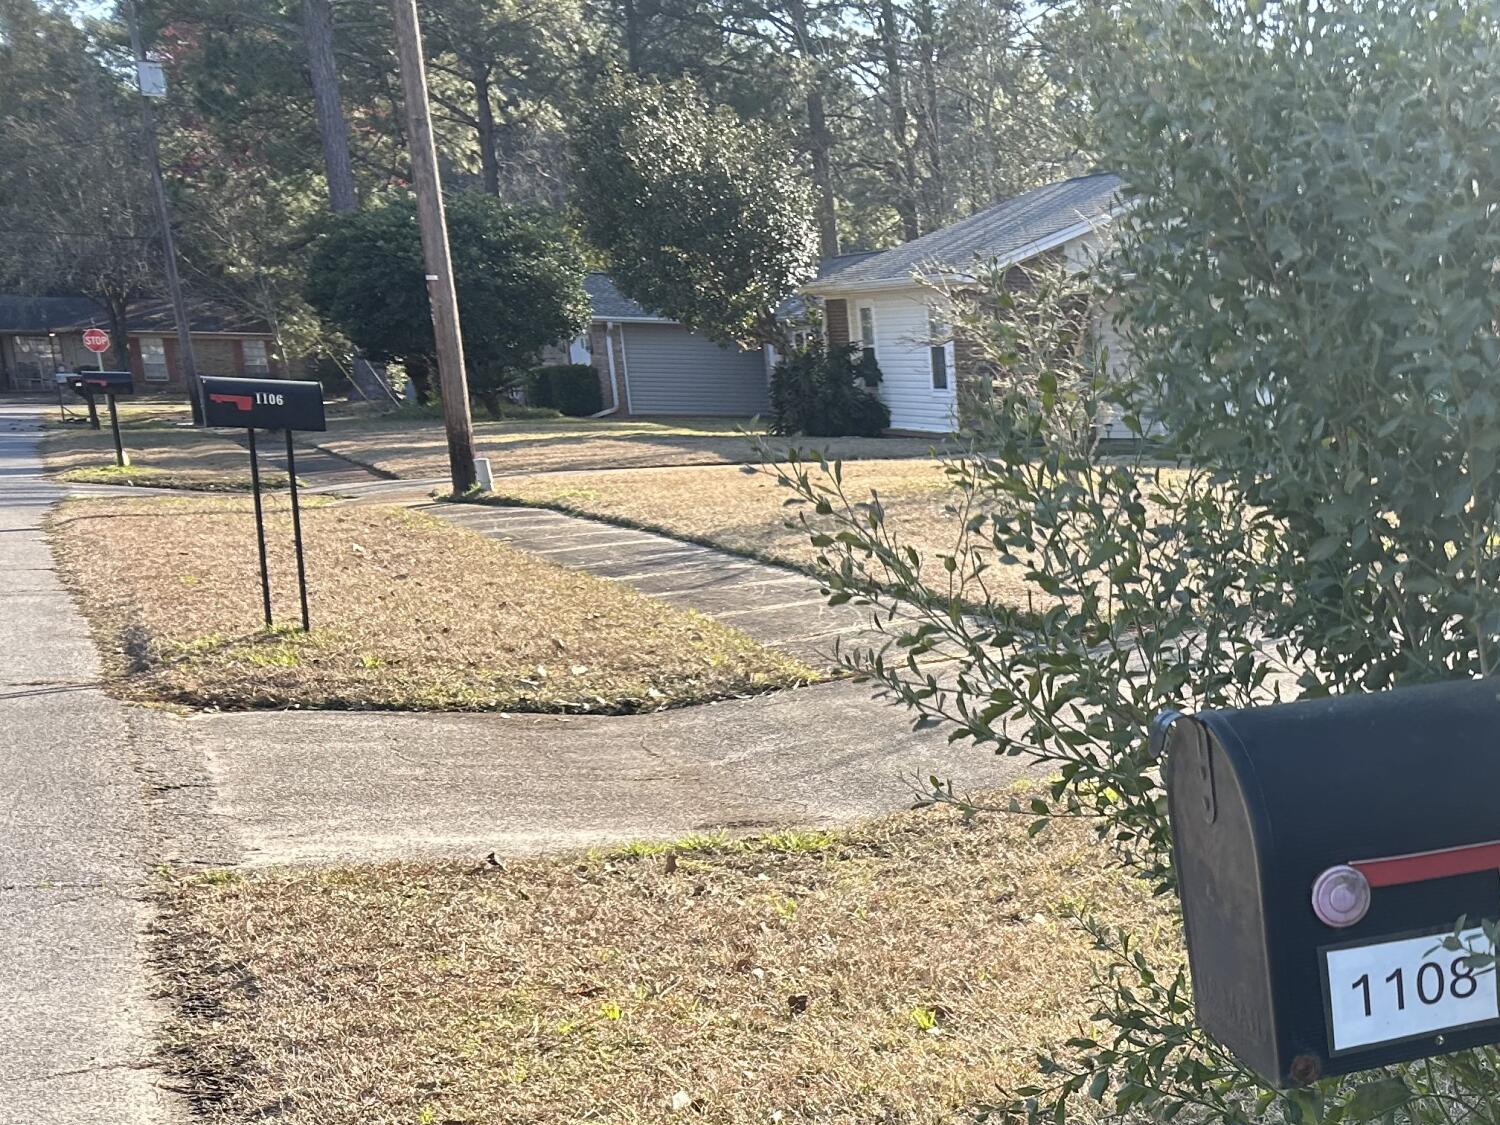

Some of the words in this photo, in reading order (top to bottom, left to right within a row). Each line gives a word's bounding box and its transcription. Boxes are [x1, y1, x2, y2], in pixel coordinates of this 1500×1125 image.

[85, 336, 107, 345] STOP
[256, 392, 284, 406] 1106
[1352, 956, 1477, 1017] 1108
